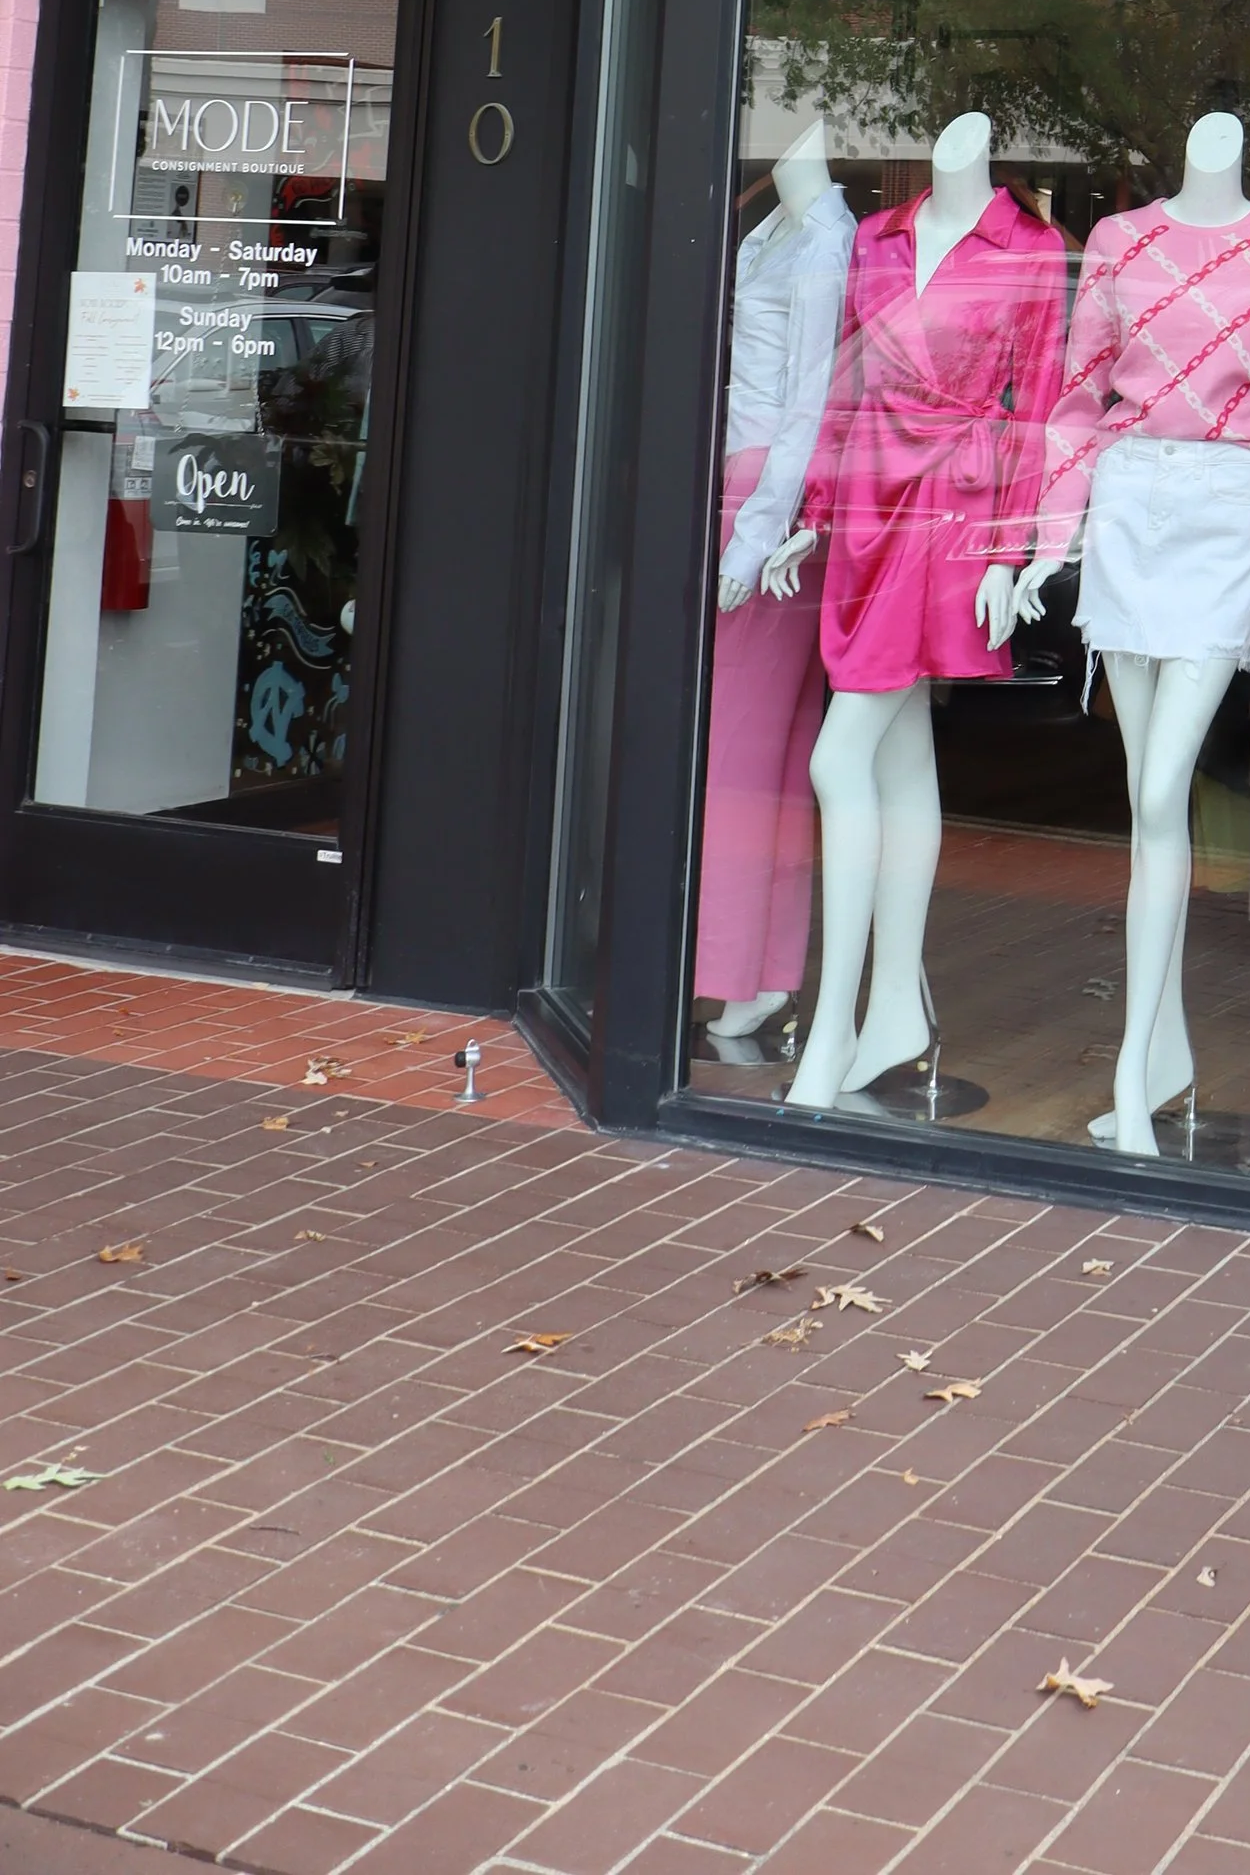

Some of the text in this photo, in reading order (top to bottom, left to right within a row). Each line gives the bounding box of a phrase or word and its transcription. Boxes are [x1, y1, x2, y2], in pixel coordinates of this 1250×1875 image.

[151, 98, 309, 154] MODE
[151, 160, 305, 174] CONSIGNMENT BOUTIQUE
[126, 237, 202, 261] Monday
[228, 240, 318, 267] Saturday
[160, 264, 211, 285] 10am
[238, 267, 279, 290] 7pm
[179, 306, 253, 332] Sunday
[154, 331, 204, 354] 12pm
[231, 334, 275, 358] 6pm
[176, 453, 256, 514] Open
